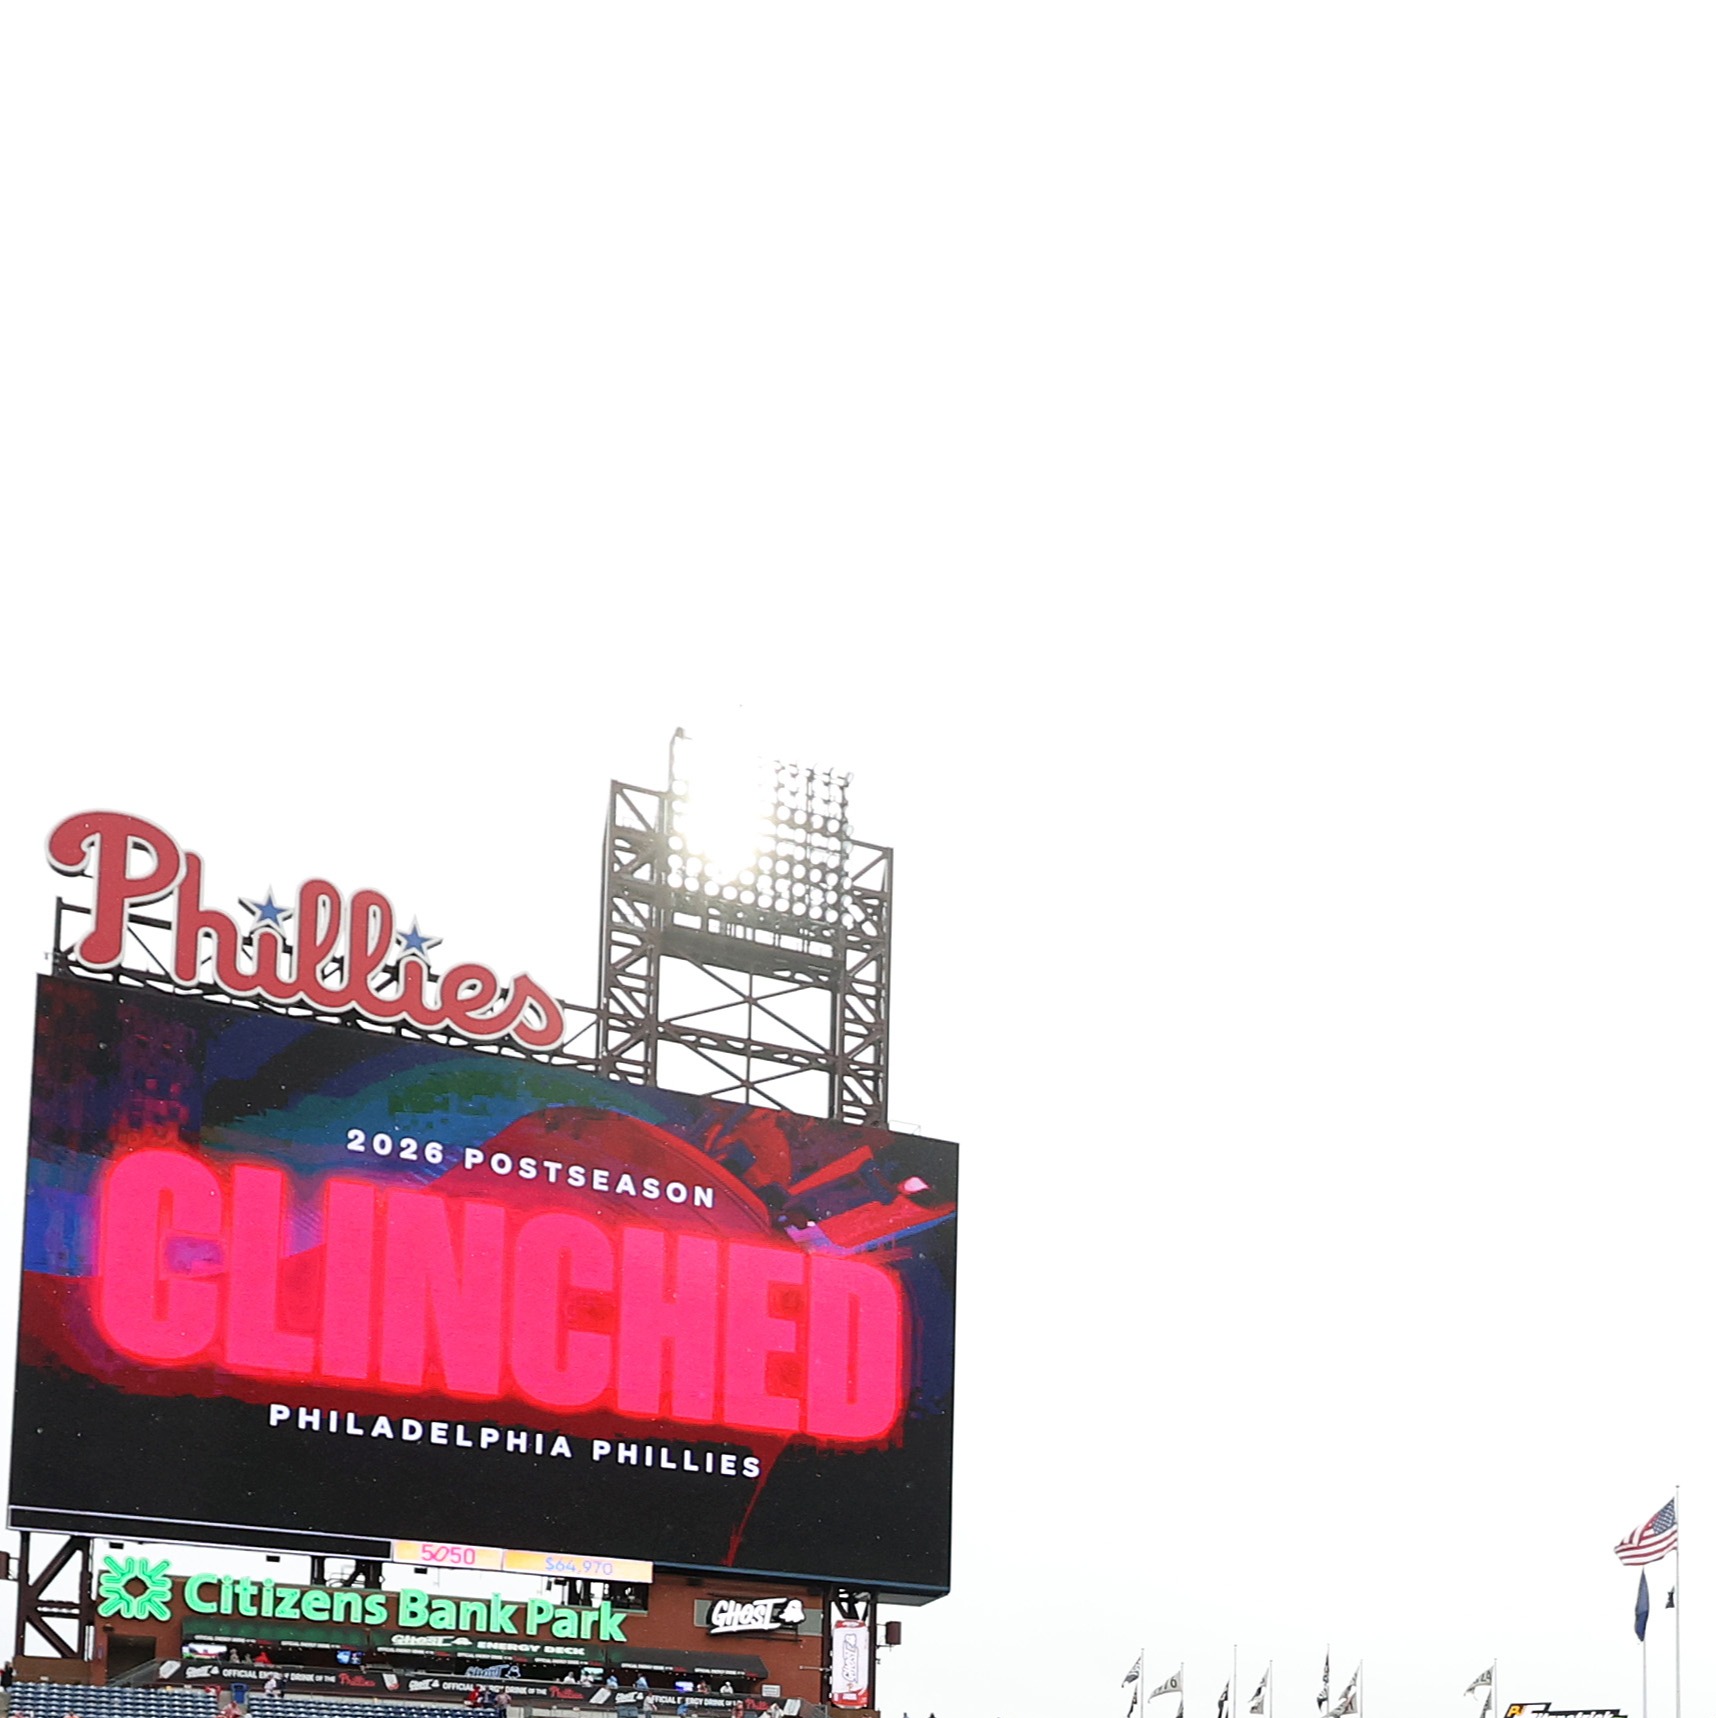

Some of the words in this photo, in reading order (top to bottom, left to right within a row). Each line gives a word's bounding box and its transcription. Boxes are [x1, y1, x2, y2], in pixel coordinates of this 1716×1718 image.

[48, 809, 564, 1050] Phillies
[346, 1128, 444, 1166] 2026
[463, 1147, 717, 1210] POSTSEASON
[101, 1148, 905, 1443] CLINCHED
[268, 1402, 573, 1458] PHILADELPHIA
[591, 1439, 762, 1479] PHILLIES
[184, 1573, 388, 1624] Citizens
[398, 1588, 519, 1635] Bank
[526, 1598, 628, 1643] Park
[711, 1598, 788, 1634] GHOST
[477, 1641, 540, 1653] ENERGY
[543, 1645, 585, 1656] DECK
